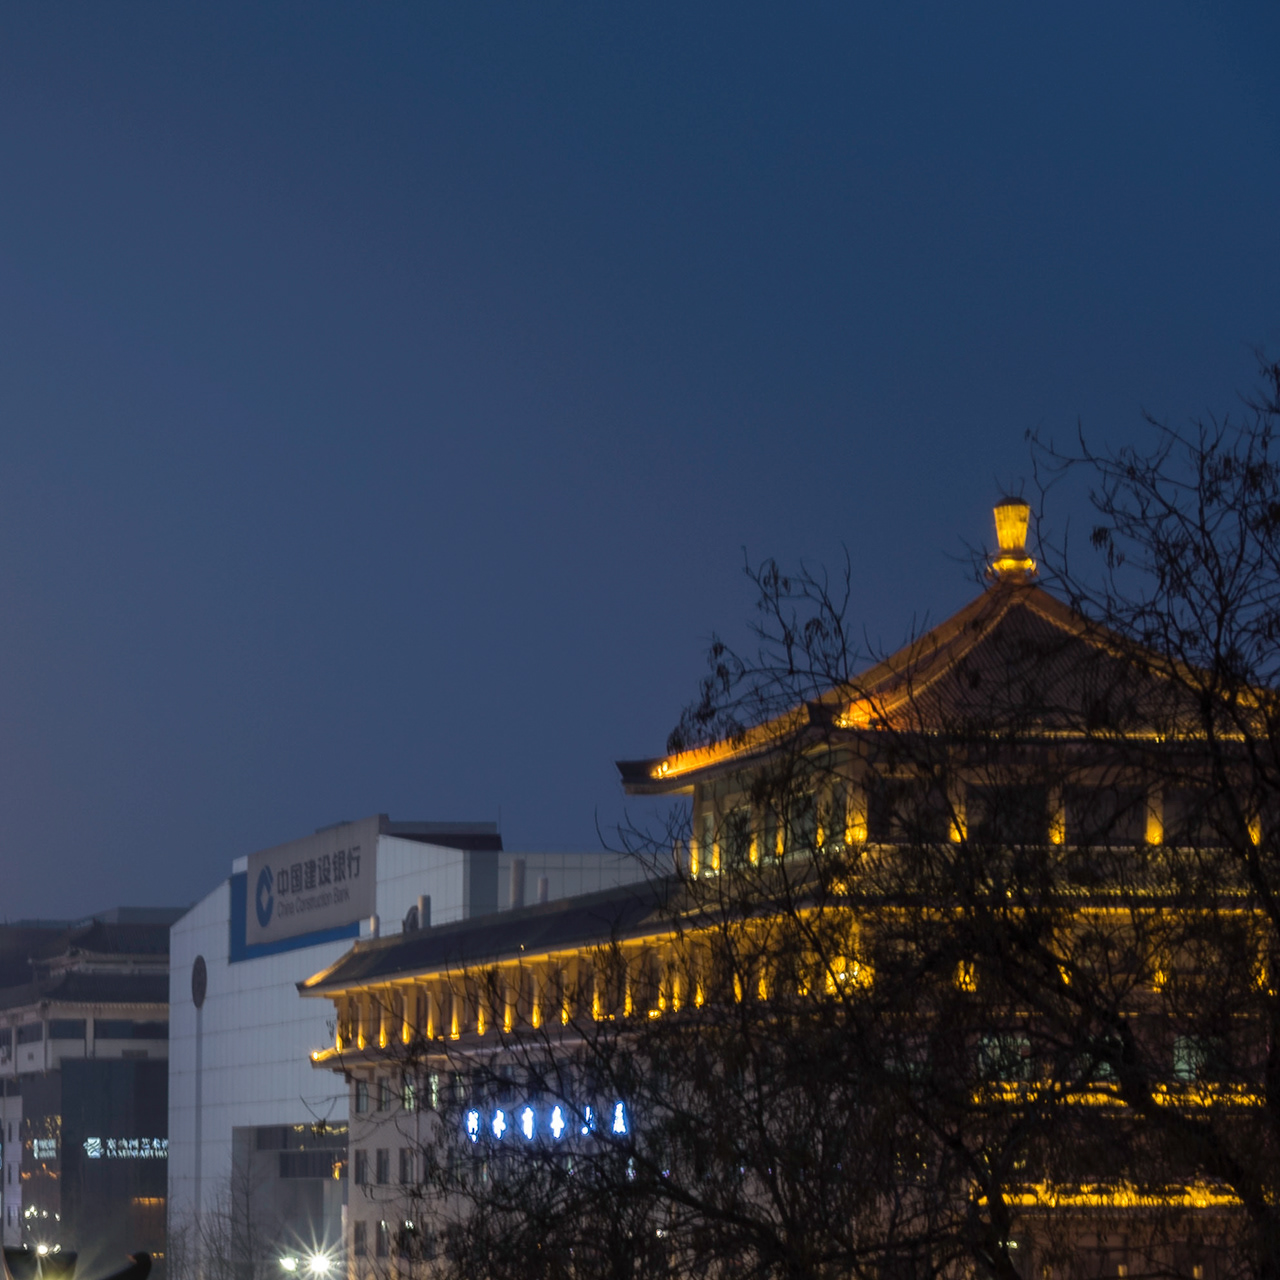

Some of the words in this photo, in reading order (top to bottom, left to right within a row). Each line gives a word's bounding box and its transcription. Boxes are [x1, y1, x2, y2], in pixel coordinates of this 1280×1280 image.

[277, 846, 361, 895] 中国建设银行
[278, 901, 295, 918] China
[296, 893, 333, 913] Construction
[334, 887, 350, 904] Bank
